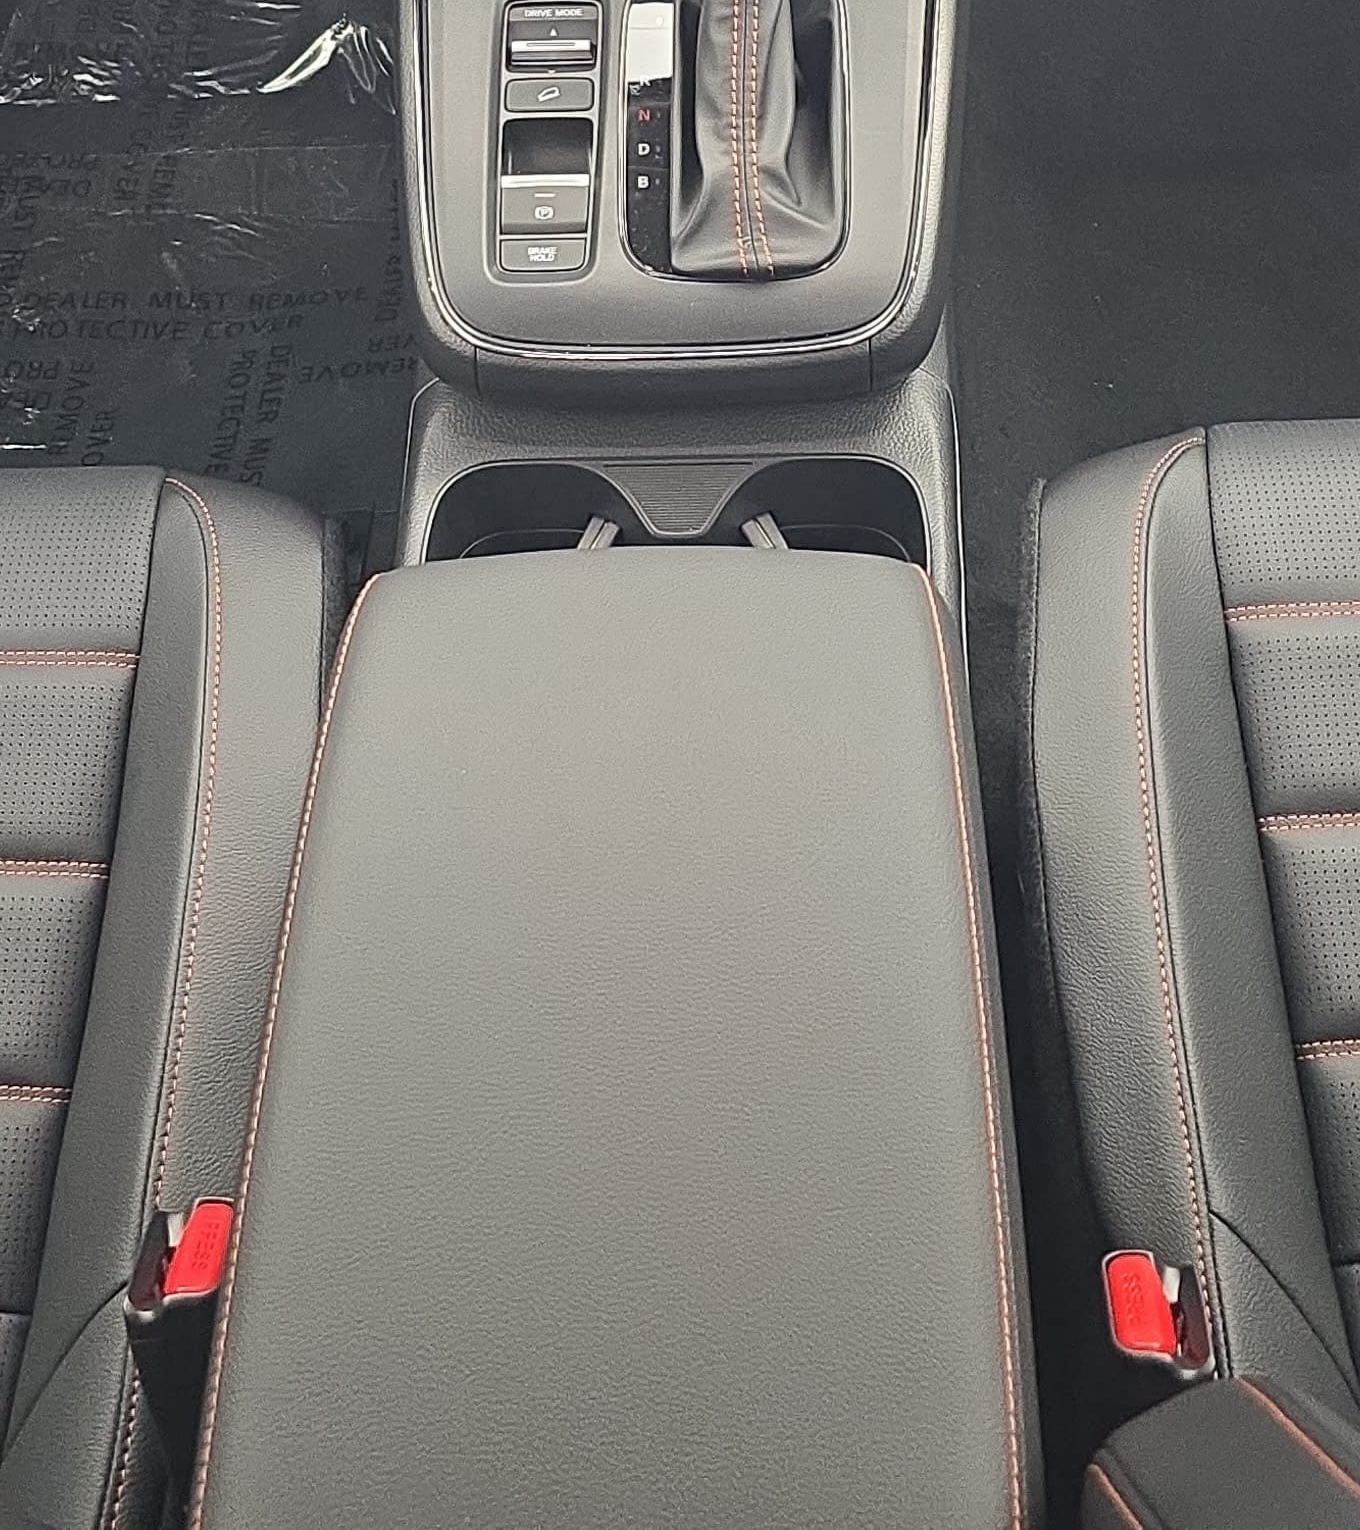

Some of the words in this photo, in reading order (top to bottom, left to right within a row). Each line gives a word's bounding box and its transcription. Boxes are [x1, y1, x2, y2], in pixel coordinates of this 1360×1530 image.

[638, 109, 650, 121] N
[638, 143, 650, 155] D
[637, 176, 649, 188] B
[528, 247, 558, 255] BRAKE
[529, 254, 554, 262] HOLD
[24, 292, 128, 310] DEALER
[147, 291, 231, 312] MUST
[249, 287, 370, 310] REMOVE
[203, 314, 306, 339] COVER
